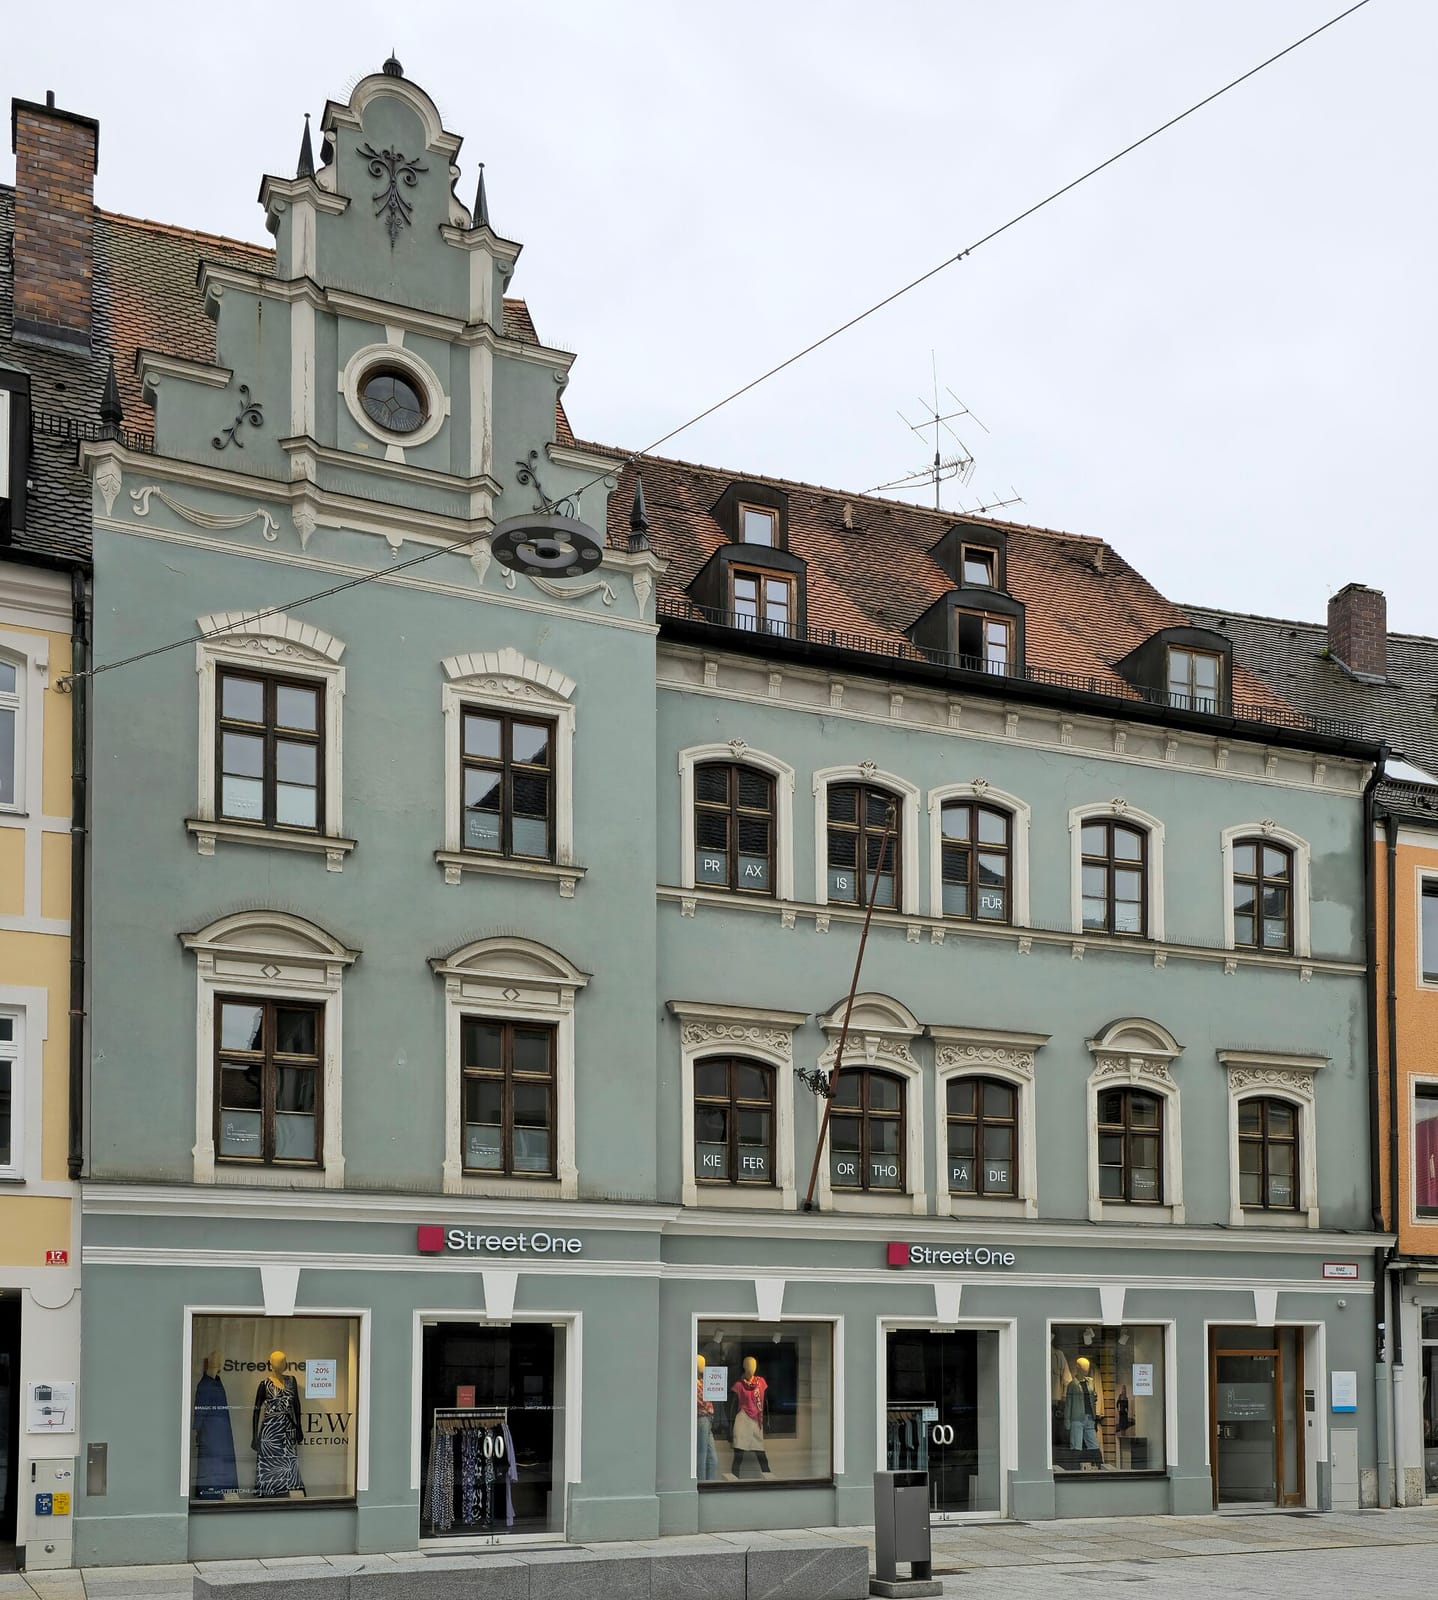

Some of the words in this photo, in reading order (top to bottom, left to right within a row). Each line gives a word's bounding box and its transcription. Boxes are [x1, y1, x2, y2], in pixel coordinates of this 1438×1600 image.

[704, 858, 720, 873] PR
[745, 864, 762, 878] AX
[836, 876, 847, 889] IS
[981, 894, 1003, 910] FÜR
[703, 1154, 721, 1167] KIE
[743, 1156, 764, 1170] FER
[837, 1162, 855, 1175] OR
[871, 1164, 897, 1177] THO
[953, 1166, 968, 1180] PÄ
[989, 1170, 1007, 1182] DIE
[447, 1229, 527, 1252] Street
[530, 1232, 582, 1253] One
[50, 1251, 63, 1260] 17
[910, 1245, 972, 1265] Street
[974, 1247, 1015, 1266] One
[223, 1359, 272, 1372] Street
[300, 1412, 353, 1433] EW
